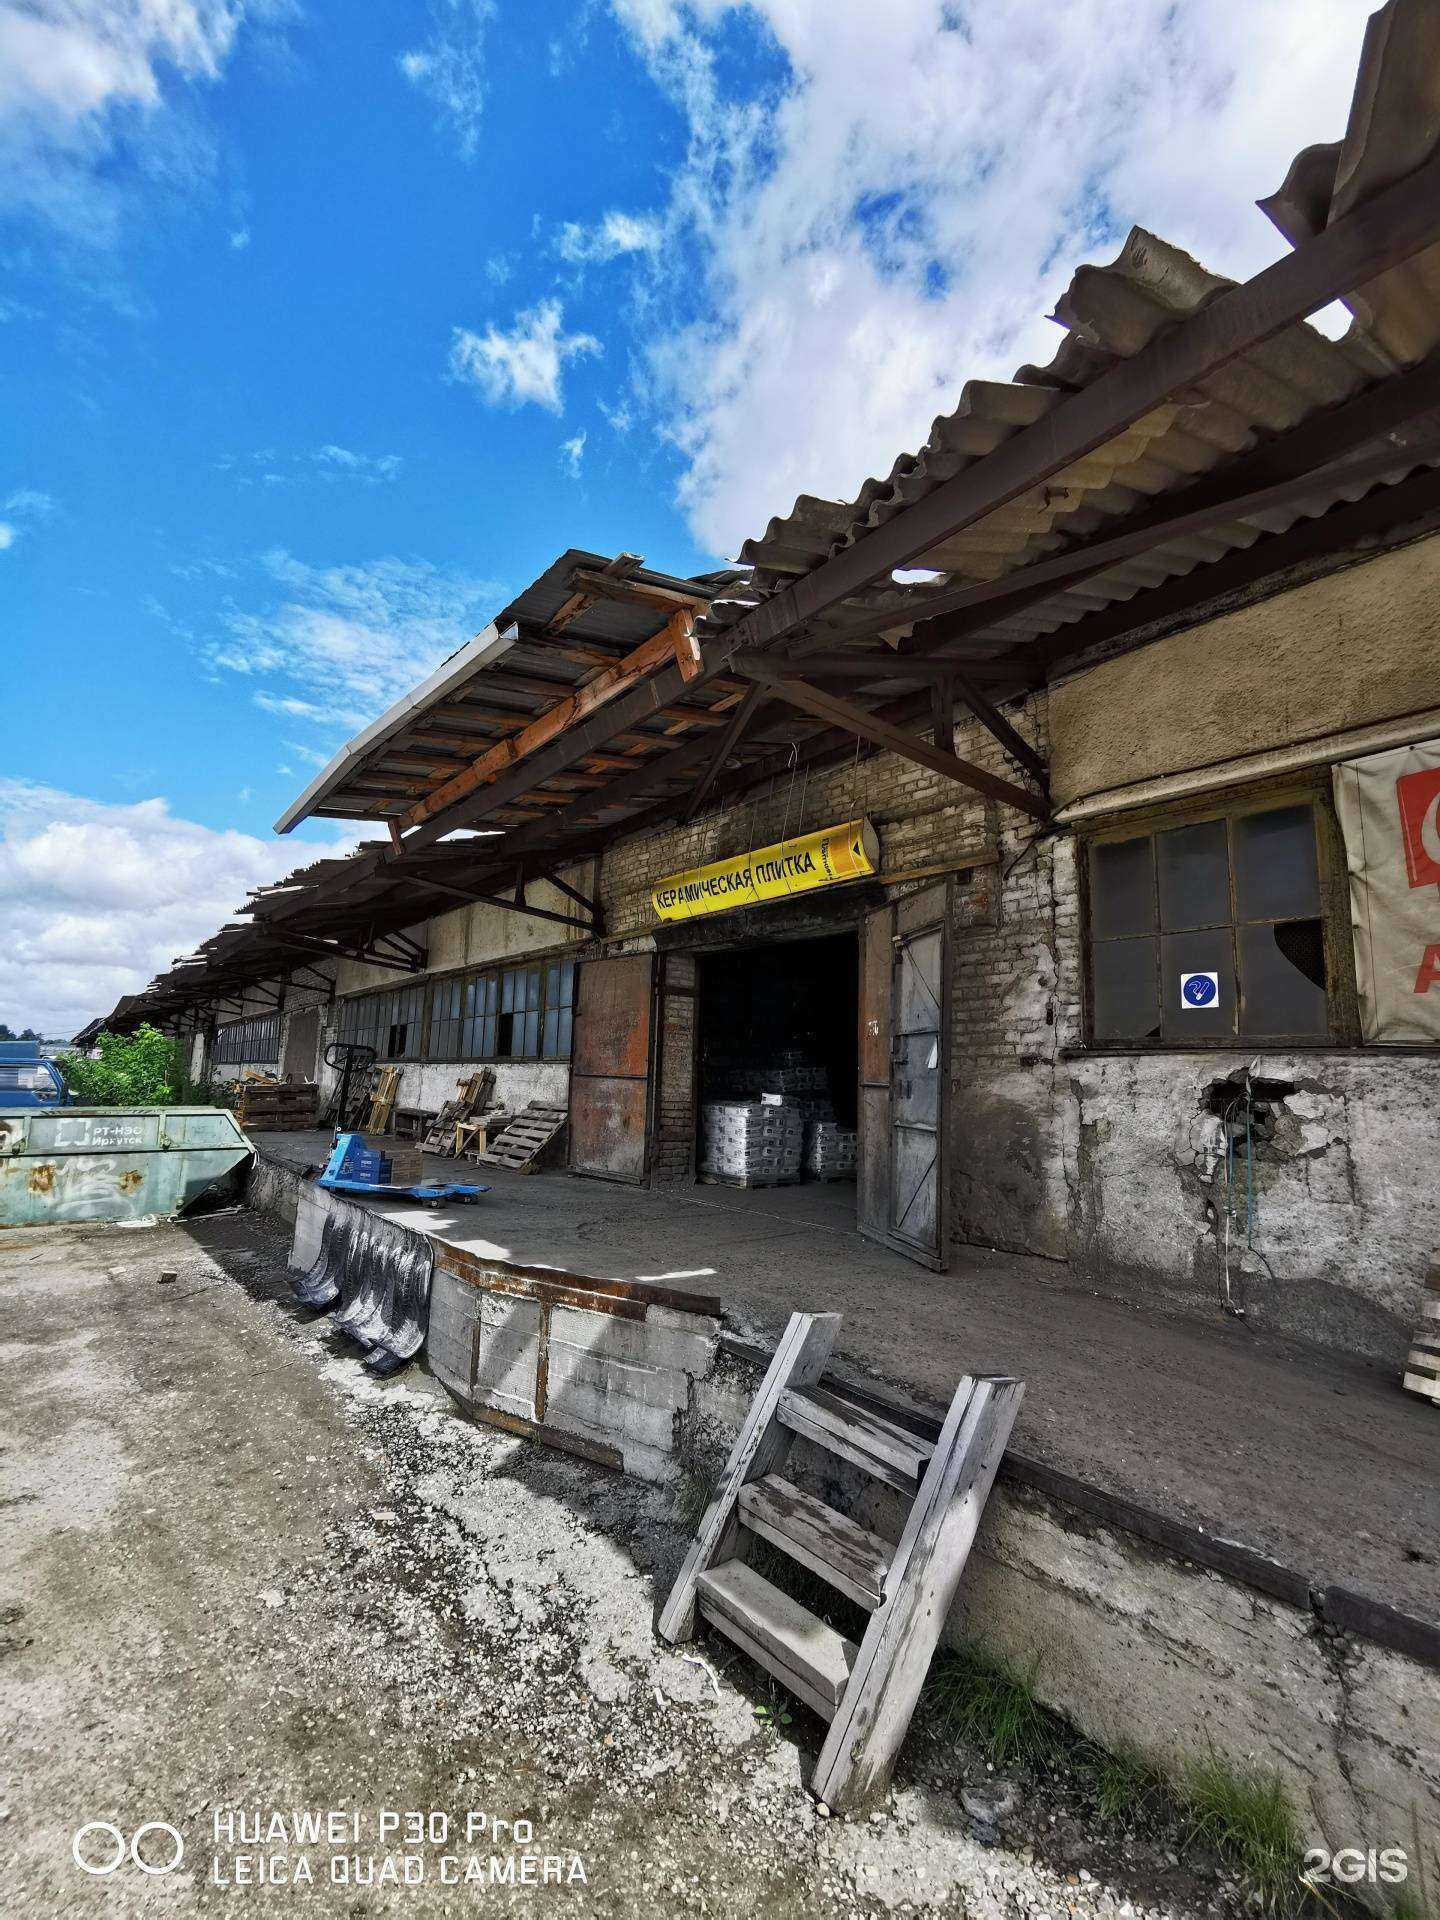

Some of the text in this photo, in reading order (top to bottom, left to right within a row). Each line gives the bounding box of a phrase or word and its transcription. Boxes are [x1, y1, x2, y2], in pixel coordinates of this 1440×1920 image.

[655, 868, 754, 909] КЕРАМИЧЕСКАЯ
[756, 851, 817, 885] ПЛИТКА
[91, 1136, 143, 1147] Иркутск
